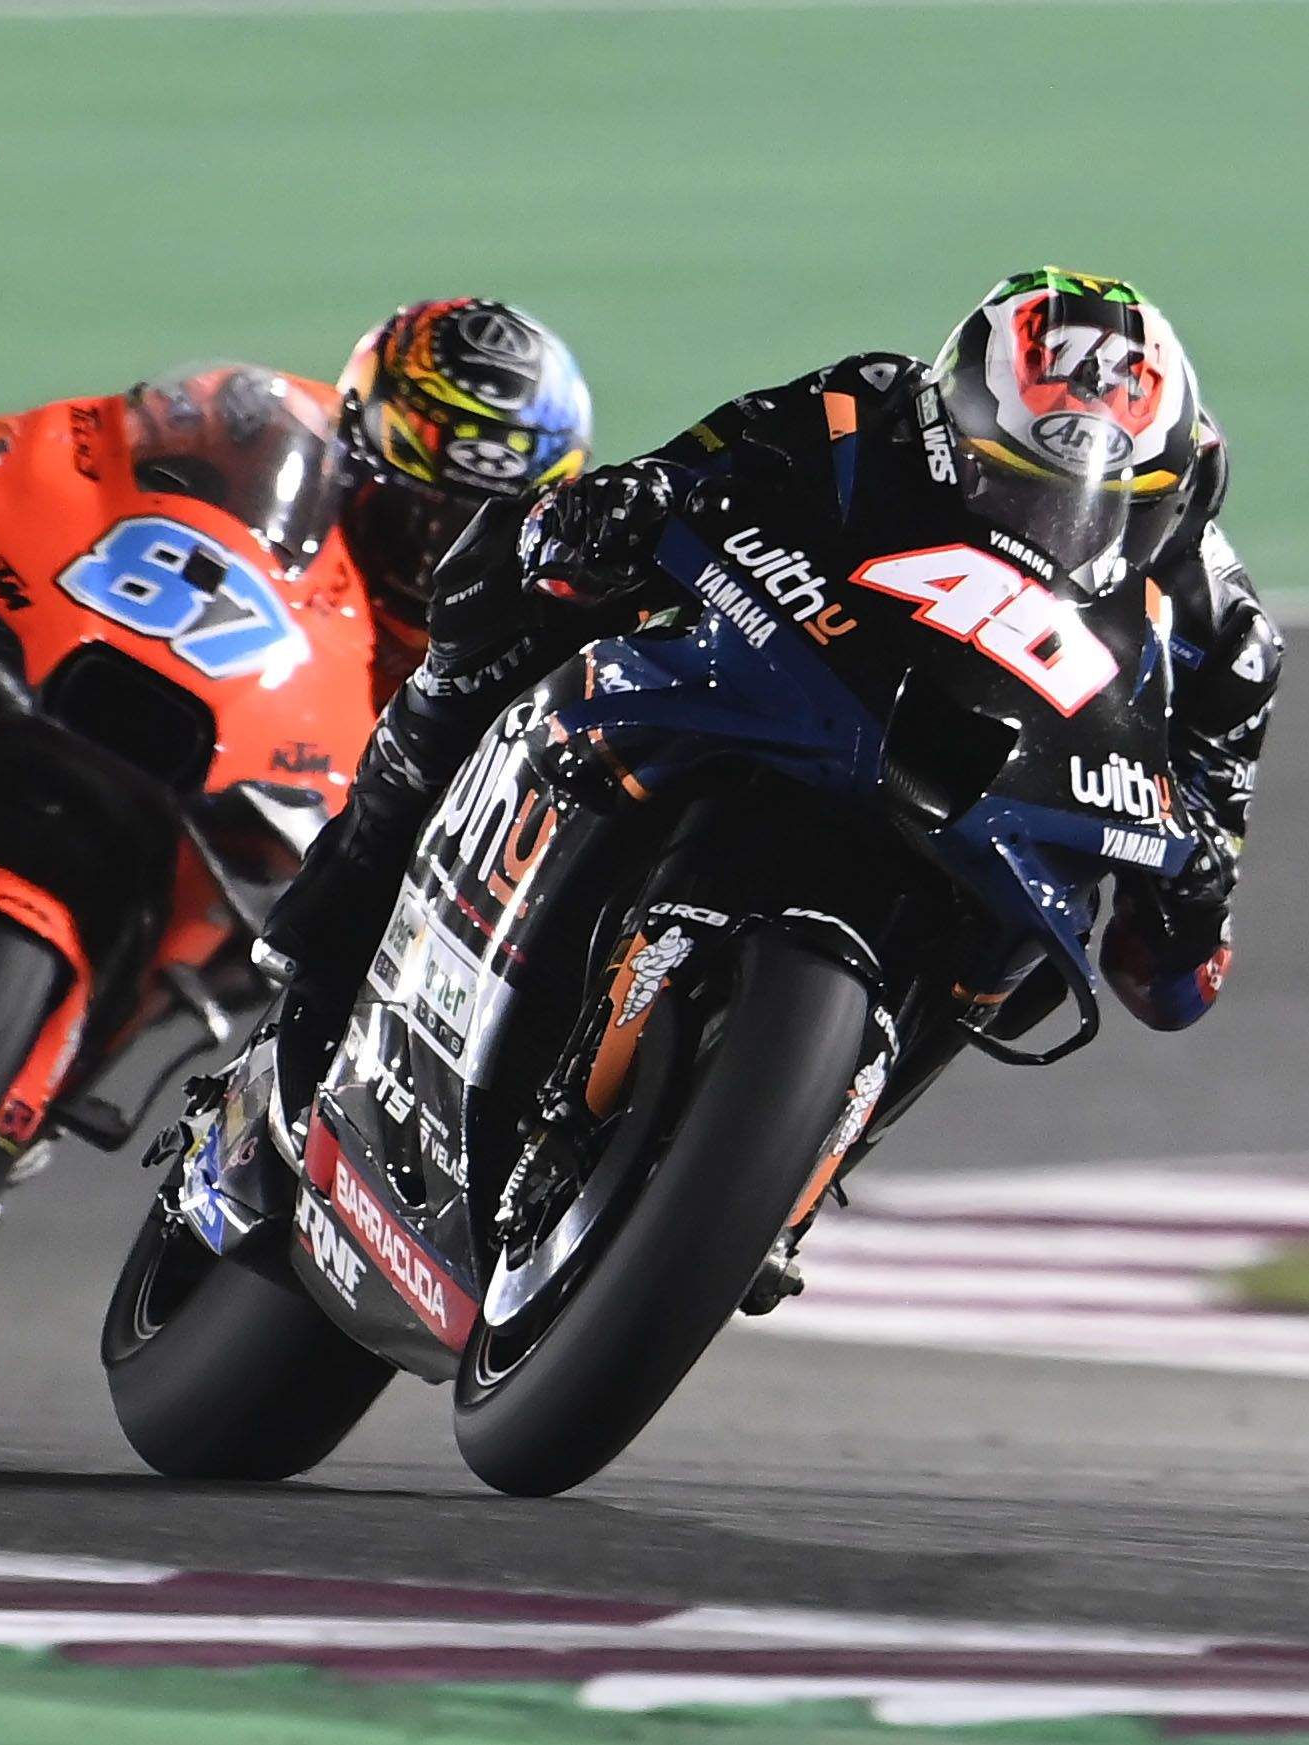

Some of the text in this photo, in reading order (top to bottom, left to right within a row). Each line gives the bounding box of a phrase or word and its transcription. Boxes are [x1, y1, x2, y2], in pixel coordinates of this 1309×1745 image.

[922, 426, 958, 485] WRS
[990, 530, 1055, 581] YAMAHA
[53, 514, 311, 685] 87
[694, 562, 778, 649] YAMAHA
[269, 741, 331, 773] KTM
[1100, 826, 1168, 868] YAMAHA
[296, 1186, 368, 1294] RNF
[335, 1159, 448, 1330] BARRACUDA
